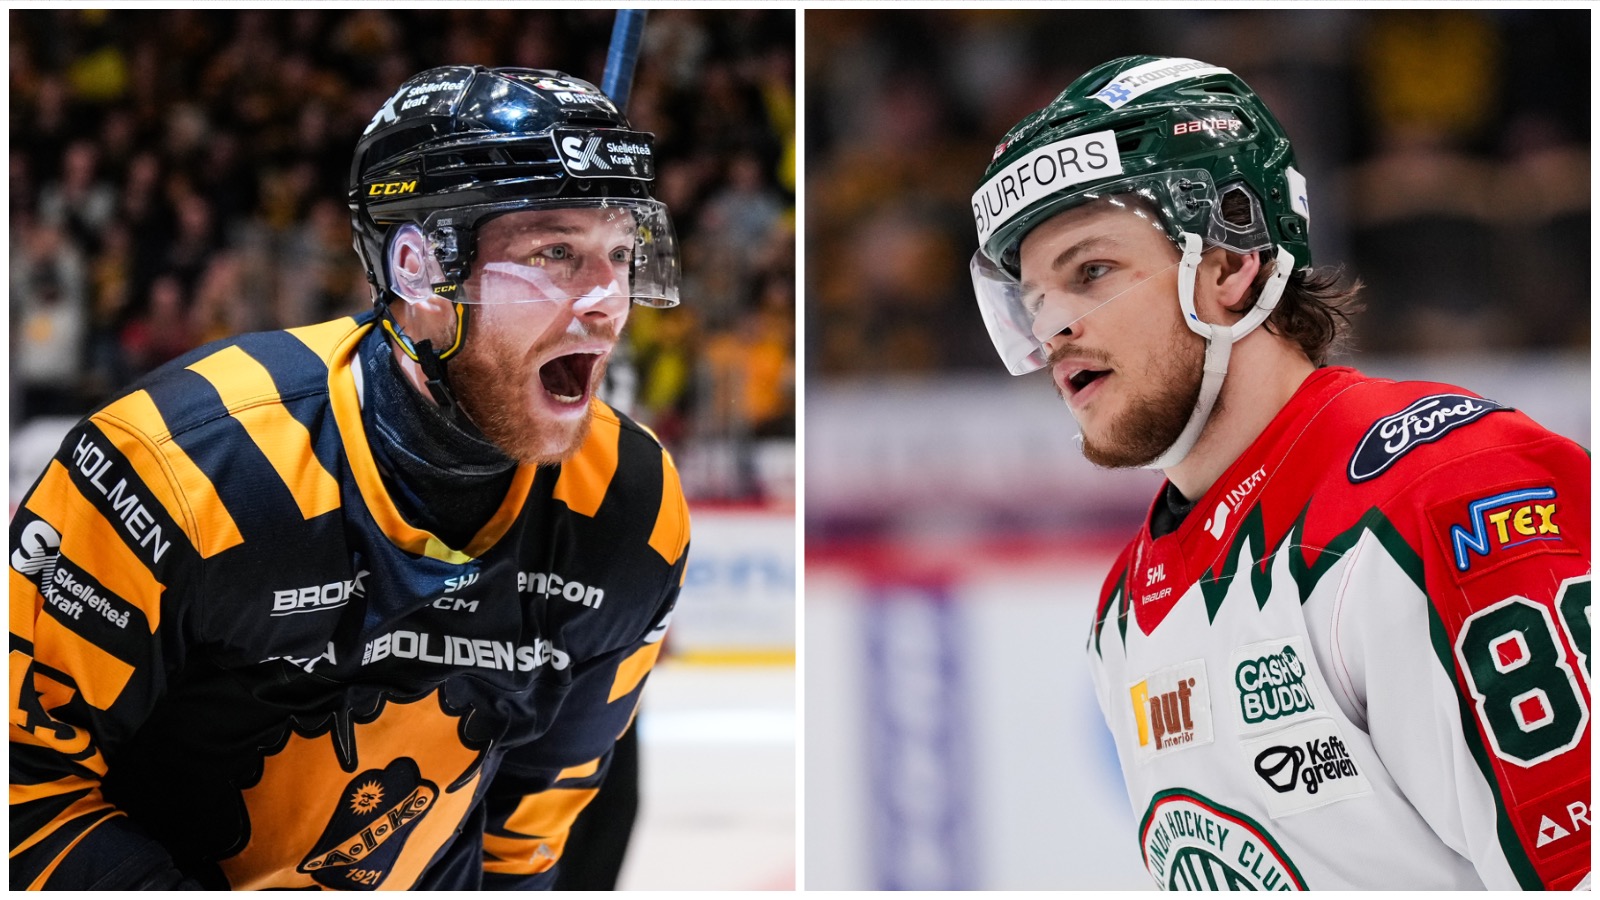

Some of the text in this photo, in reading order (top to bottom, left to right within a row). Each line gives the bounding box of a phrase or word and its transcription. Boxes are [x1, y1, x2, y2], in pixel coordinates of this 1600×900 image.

[401, 95, 430, 111] Kraft
[606, 142, 651, 156] Skellefteå
[610, 154, 635, 166] Kraft
[369, 180, 417, 197] CCM
[973, 140, 1109, 236] BJURFORS
[434, 284, 457, 294] CCM
[1380, 399, 1482, 454] Ford
[72, 433, 172, 564] HOLMEN
[1146, 563, 1166, 587] SHL
[43, 583, 84, 621] Kraft
[53, 567, 131, 629] Skellefteå
[433, 597, 480, 613] CM
[370, 630, 514, 672] BOLIDEN
[1239, 653, 1294, 692] CASH
[1306, 736, 1349, 765] Kaffe
[1301, 758, 1358, 795] greven
[1165, 810, 1229, 851] HOCKEY
[345, 868, 382, 885] 1921
